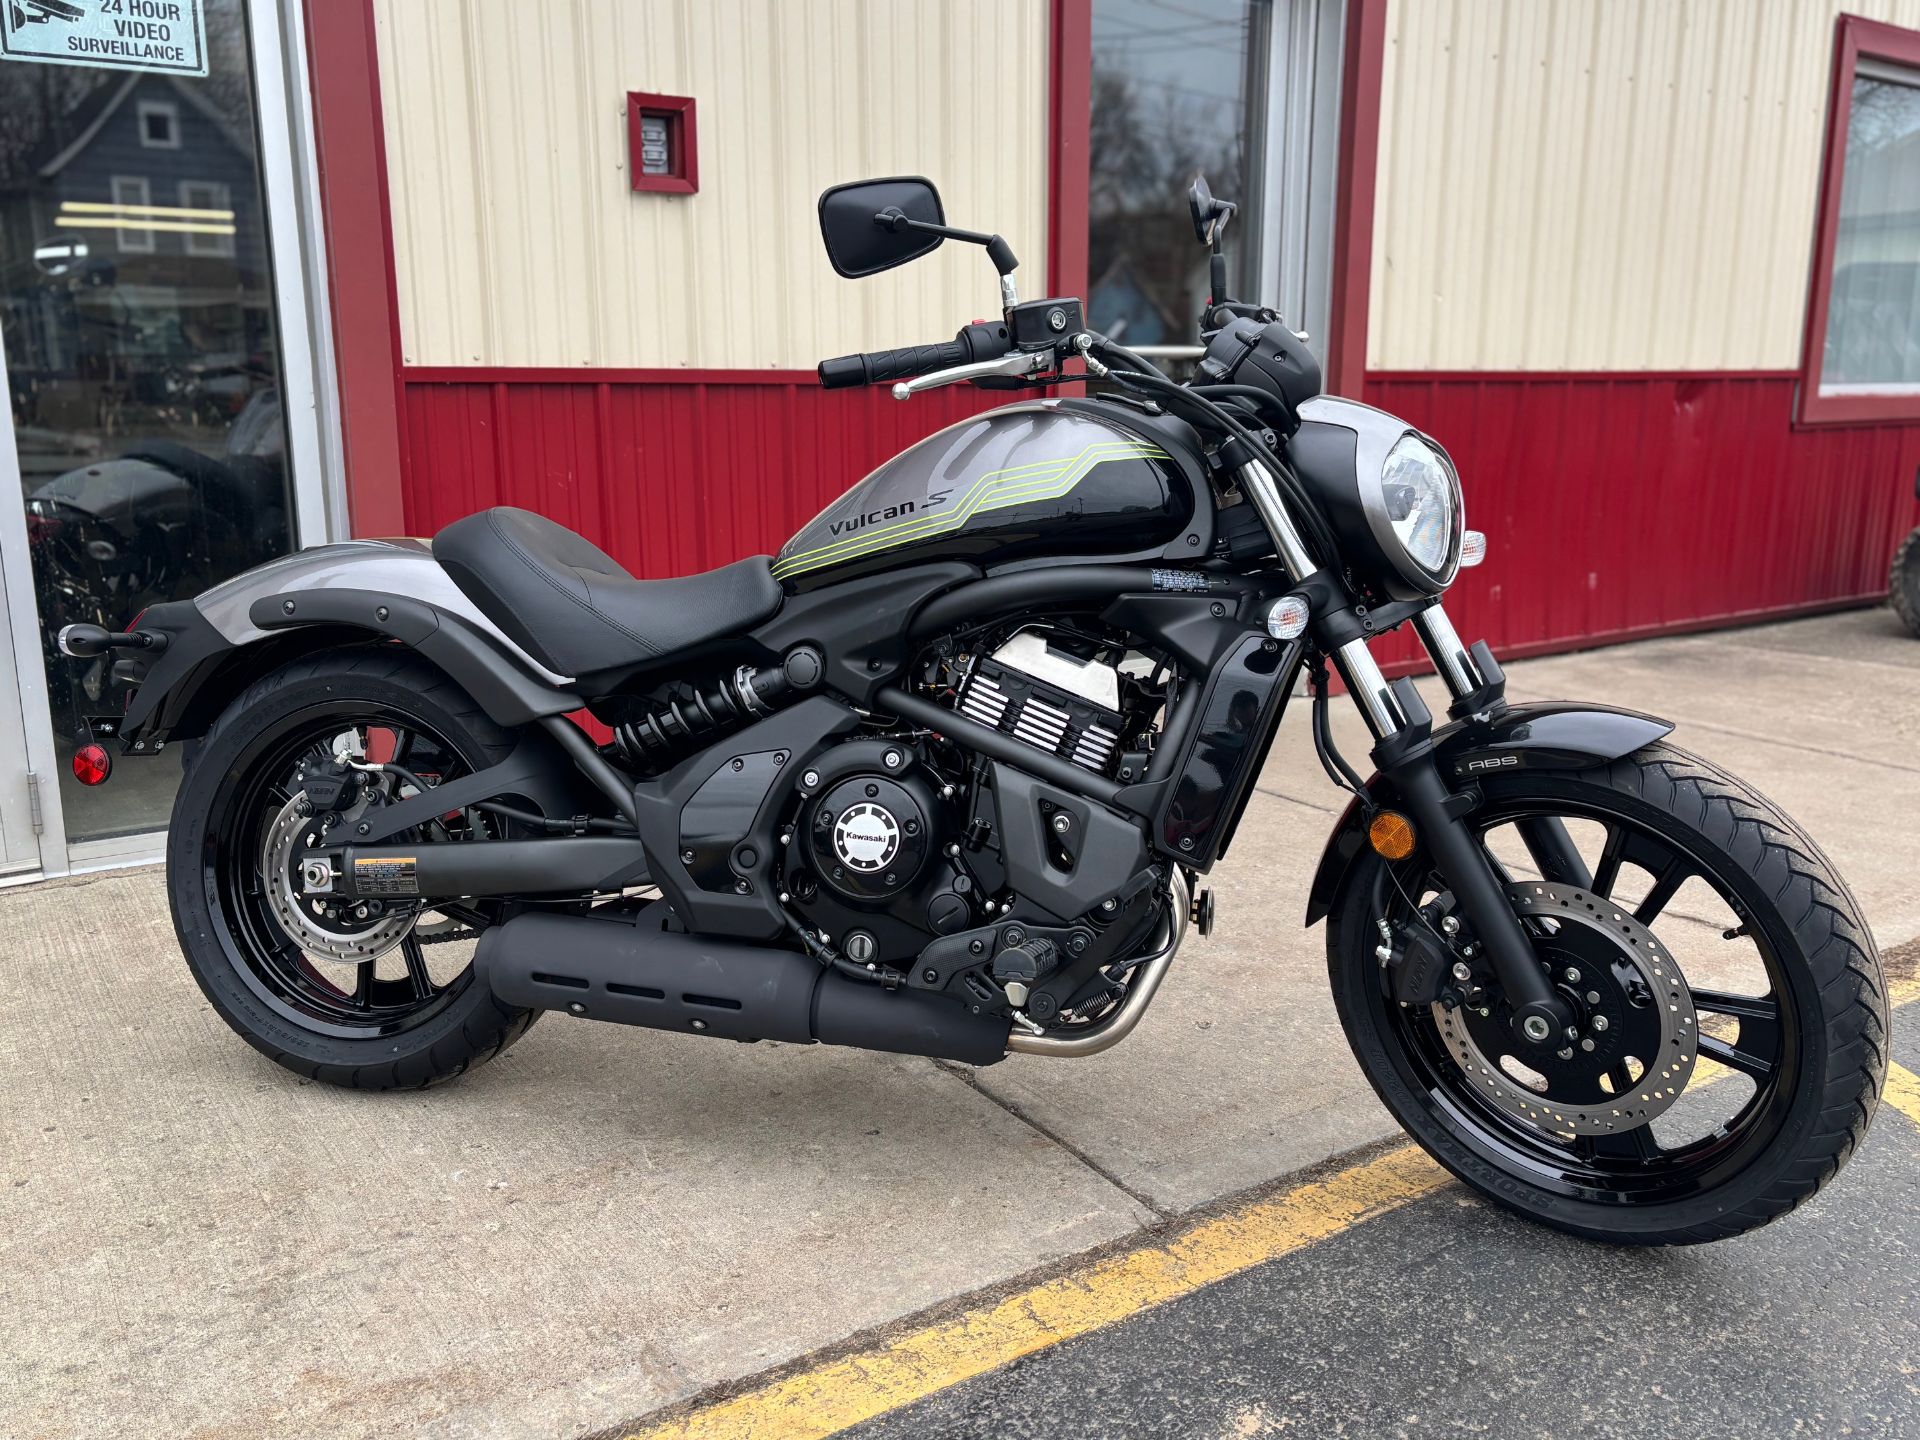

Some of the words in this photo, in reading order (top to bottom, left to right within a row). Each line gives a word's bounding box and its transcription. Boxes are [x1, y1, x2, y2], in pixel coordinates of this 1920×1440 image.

[99, 0, 123, 15] 24
[128, 0, 181, 21] HOUR
[113, 19, 171, 42] VIDEO
[67, 36, 185, 61] SURVEILLANCE
[920, 488, 954, 509] S
[1468, 755, 1518, 771] ABS
[846, 831, 887, 843] Kawasaki
